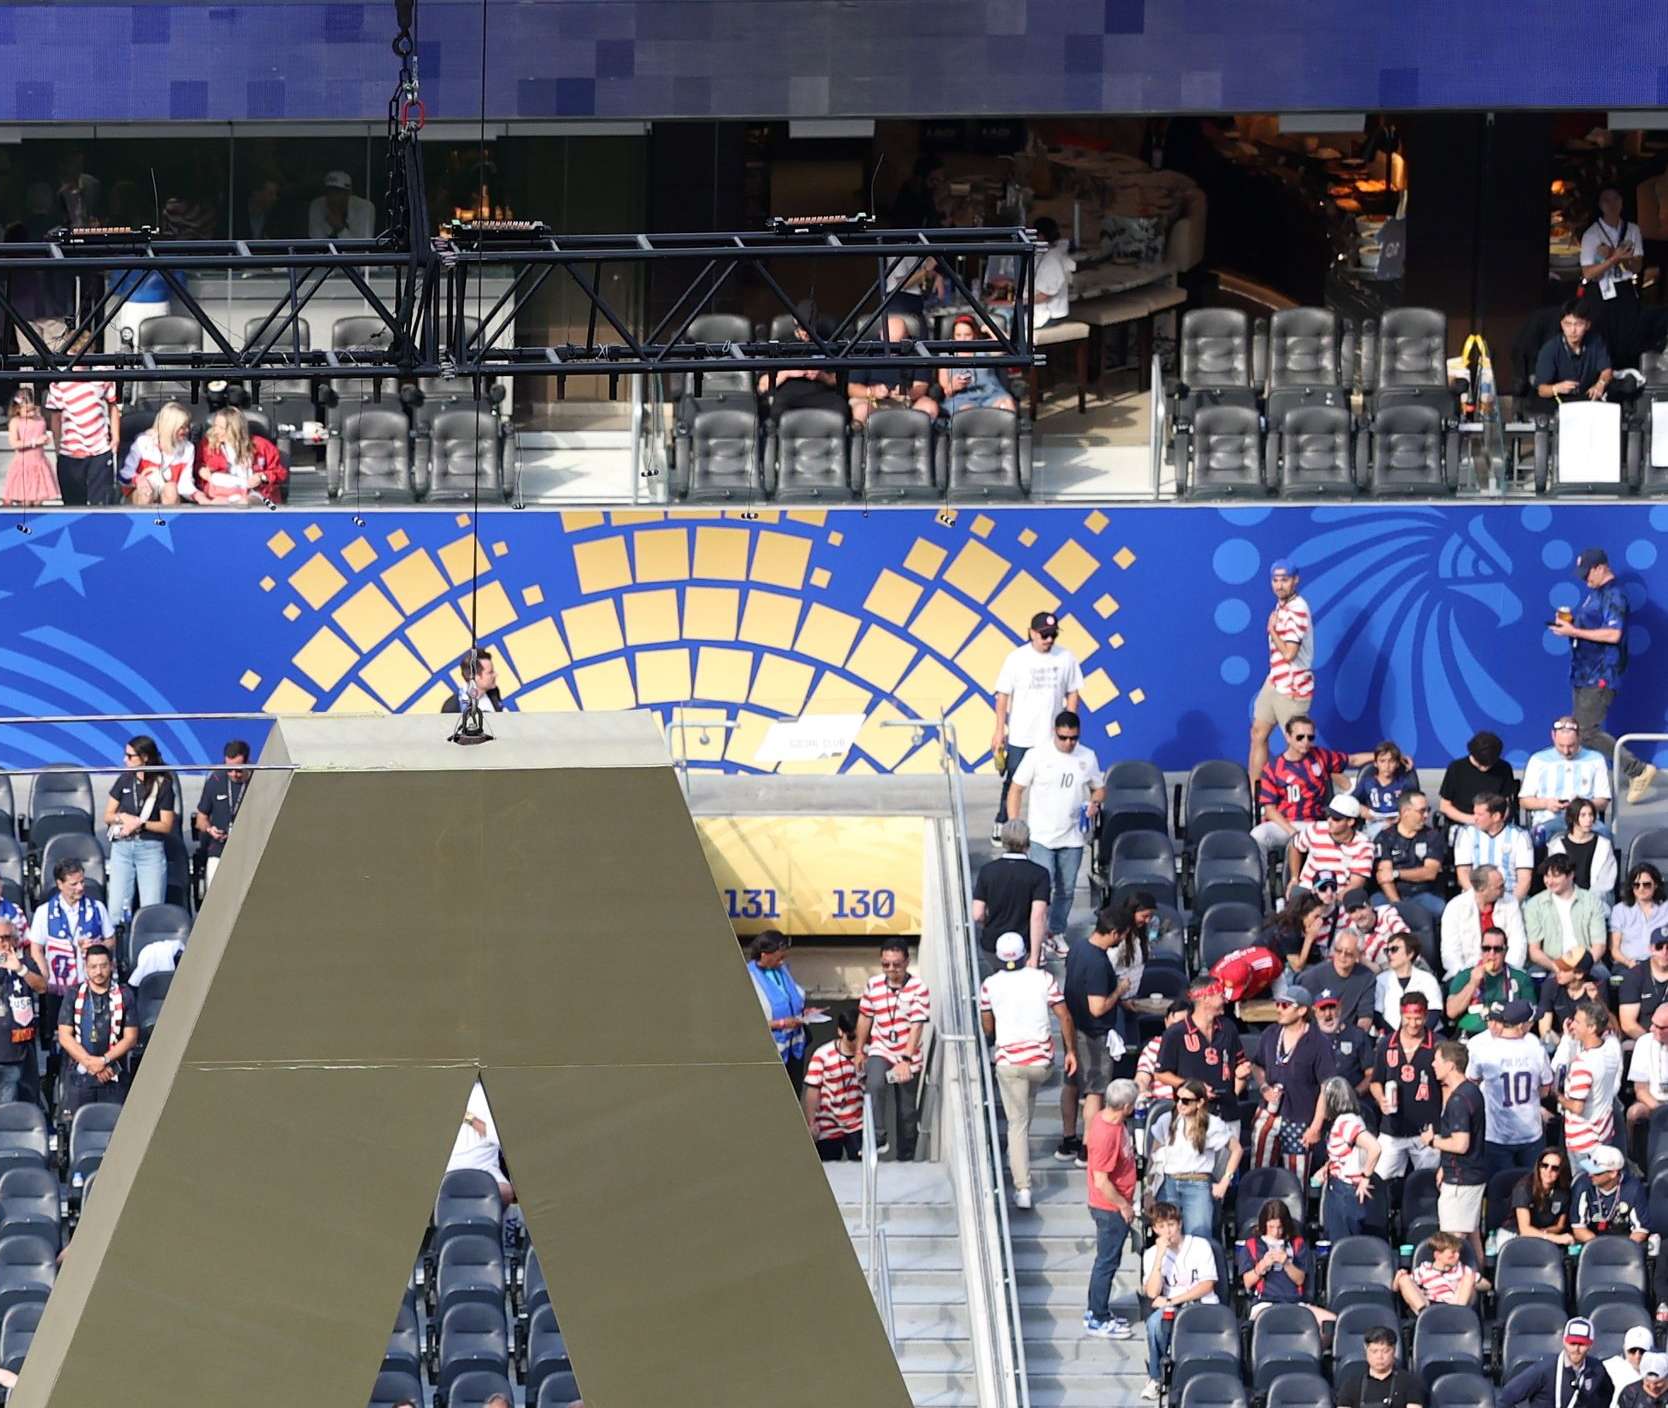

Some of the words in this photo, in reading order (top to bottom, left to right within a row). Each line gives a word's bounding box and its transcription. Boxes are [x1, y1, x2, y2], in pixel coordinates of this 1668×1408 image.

[1059, 773, 1074, 788] 10
[1287, 785, 1300, 803] 10
[726, 888, 781, 918] 131
[831, 888, 897, 918] 130
[1499, 1071, 1532, 1108] 10
